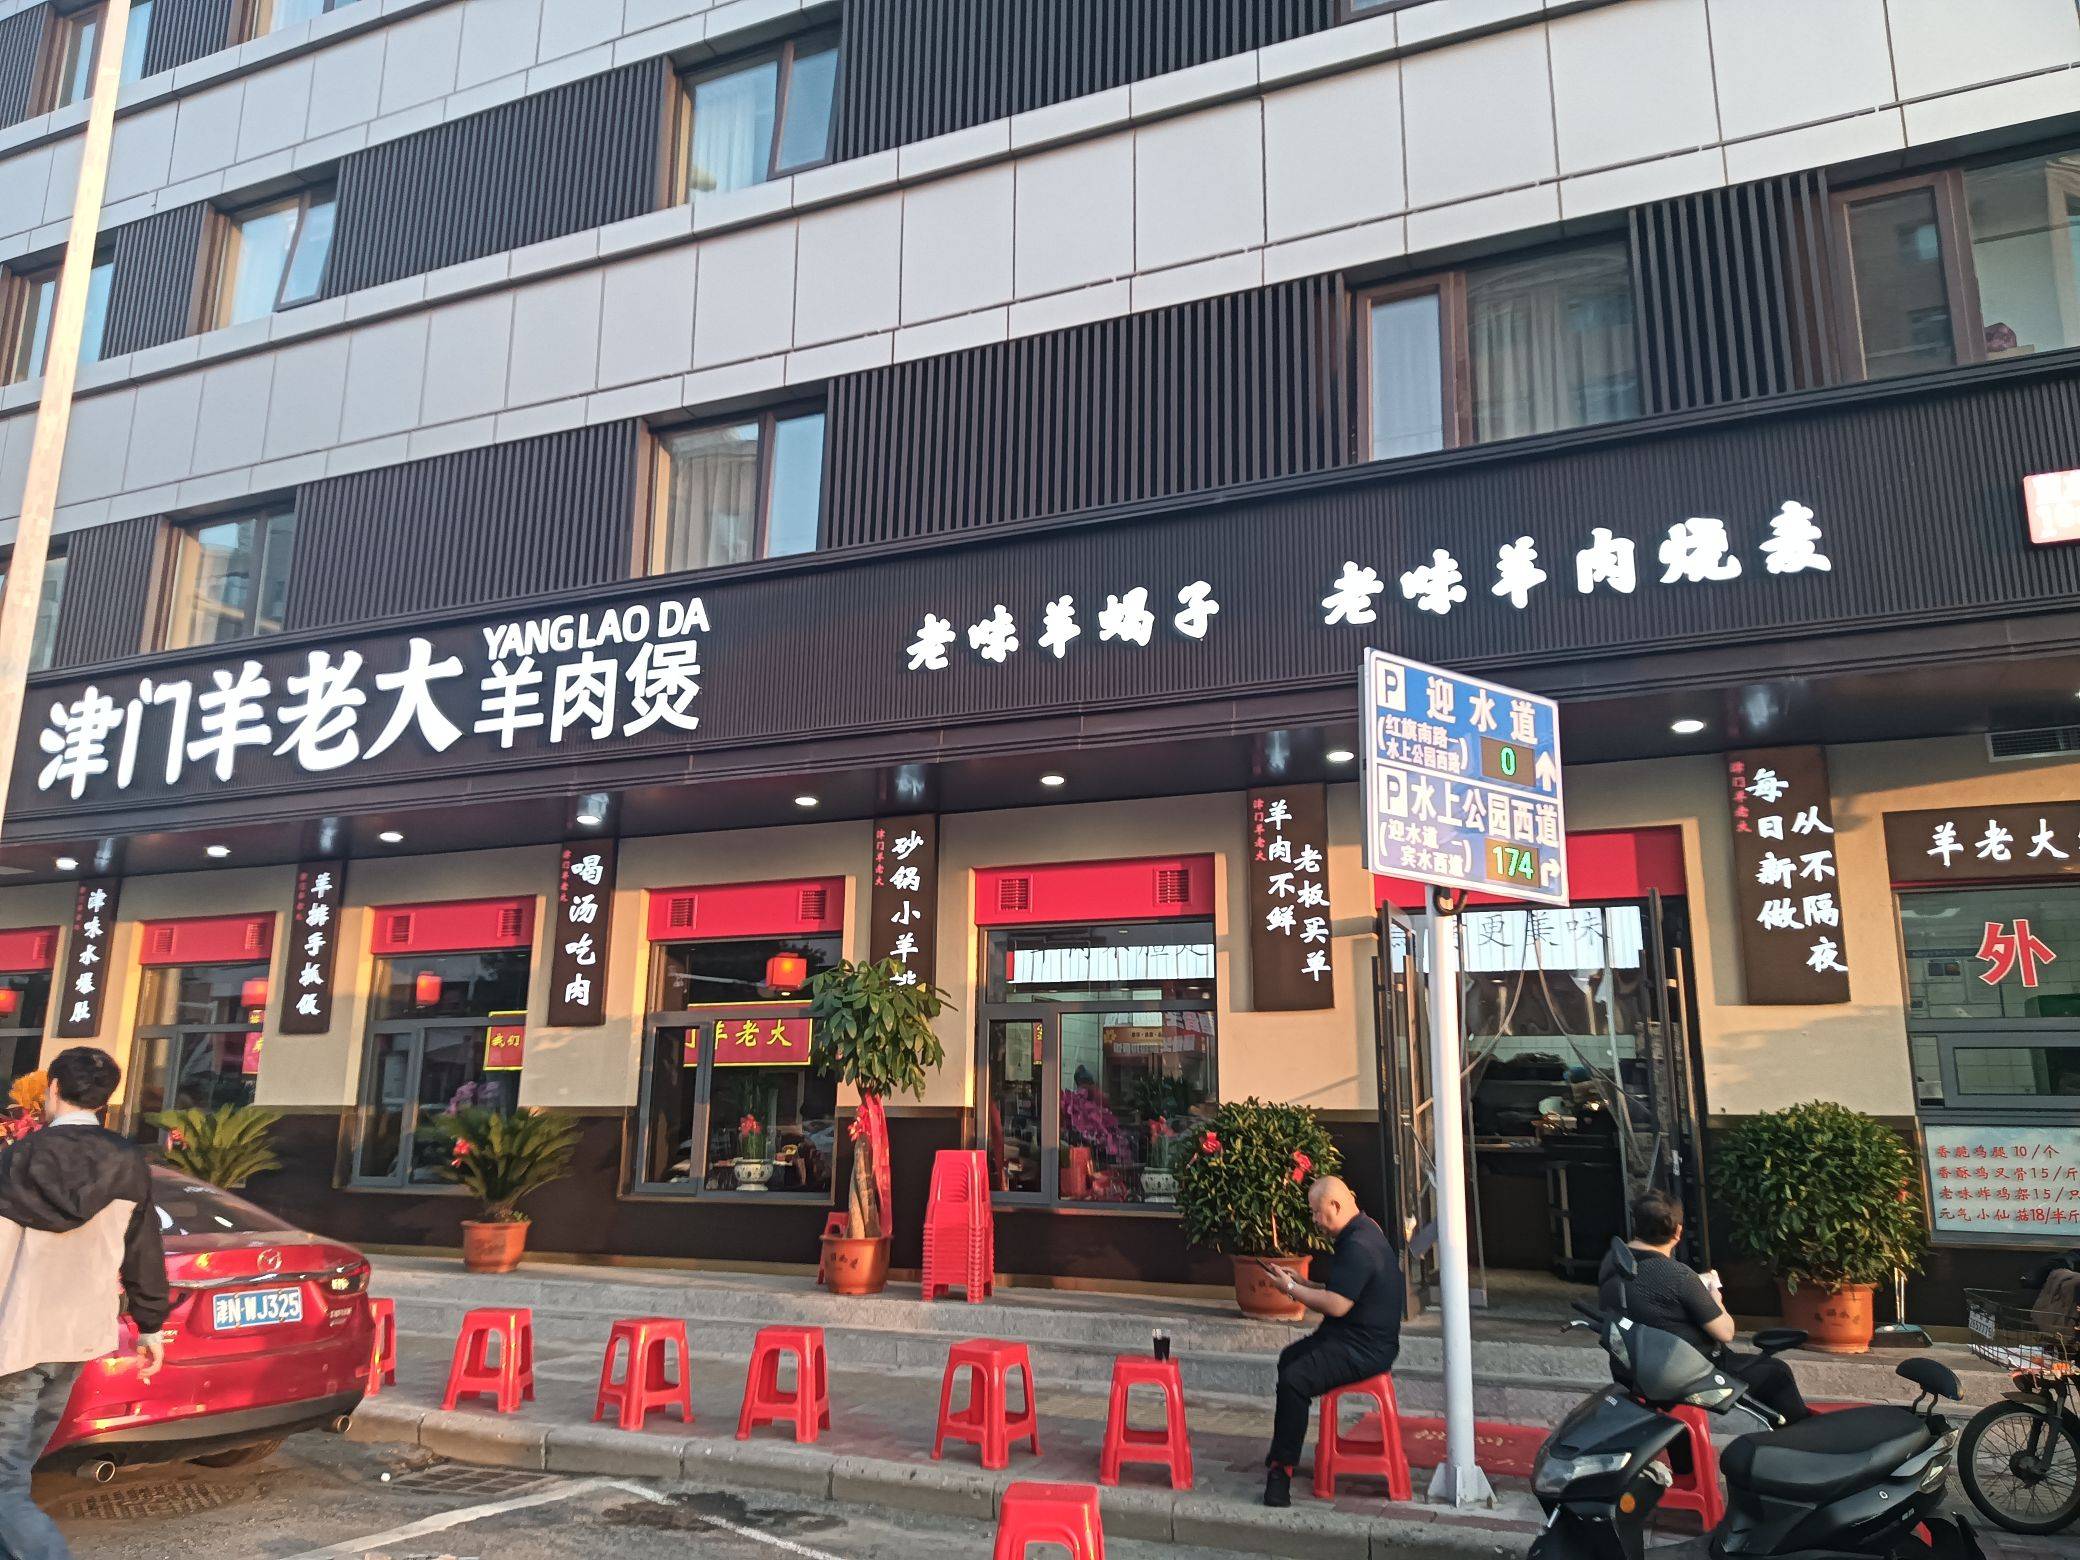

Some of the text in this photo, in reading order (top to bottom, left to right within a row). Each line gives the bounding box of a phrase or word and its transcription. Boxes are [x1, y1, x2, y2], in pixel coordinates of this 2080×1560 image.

[1321, 500, 1832, 626] 老味羊肉烧麦
[657, 597, 711, 638] DA
[906, 580, 1220, 670] 老味羊蝎子
[37, 636, 702, 799] 津门羊老大 羊肉煲
[1426, 675, 1538, 745] 迎水道
[1500, 746, 1517, 776] 0
[1252, 799, 1267, 862] 津门羊老大
[1411, 775, 1560, 849] 水上公园西道
[1745, 768, 1805, 930] 每日新做
[1926, 818, 2080, 867] 羊老大
[1264, 799, 1297, 936] 羊肉不鲜
[1492, 845, 1534, 880] 174
[1791, 806, 1848, 973] 从不隔夜
[564, 854, 604, 1006] 喝汤吃肉
[1293, 844, 1331, 982] 老板买单
[1975, 918, 2057, 988] 外
